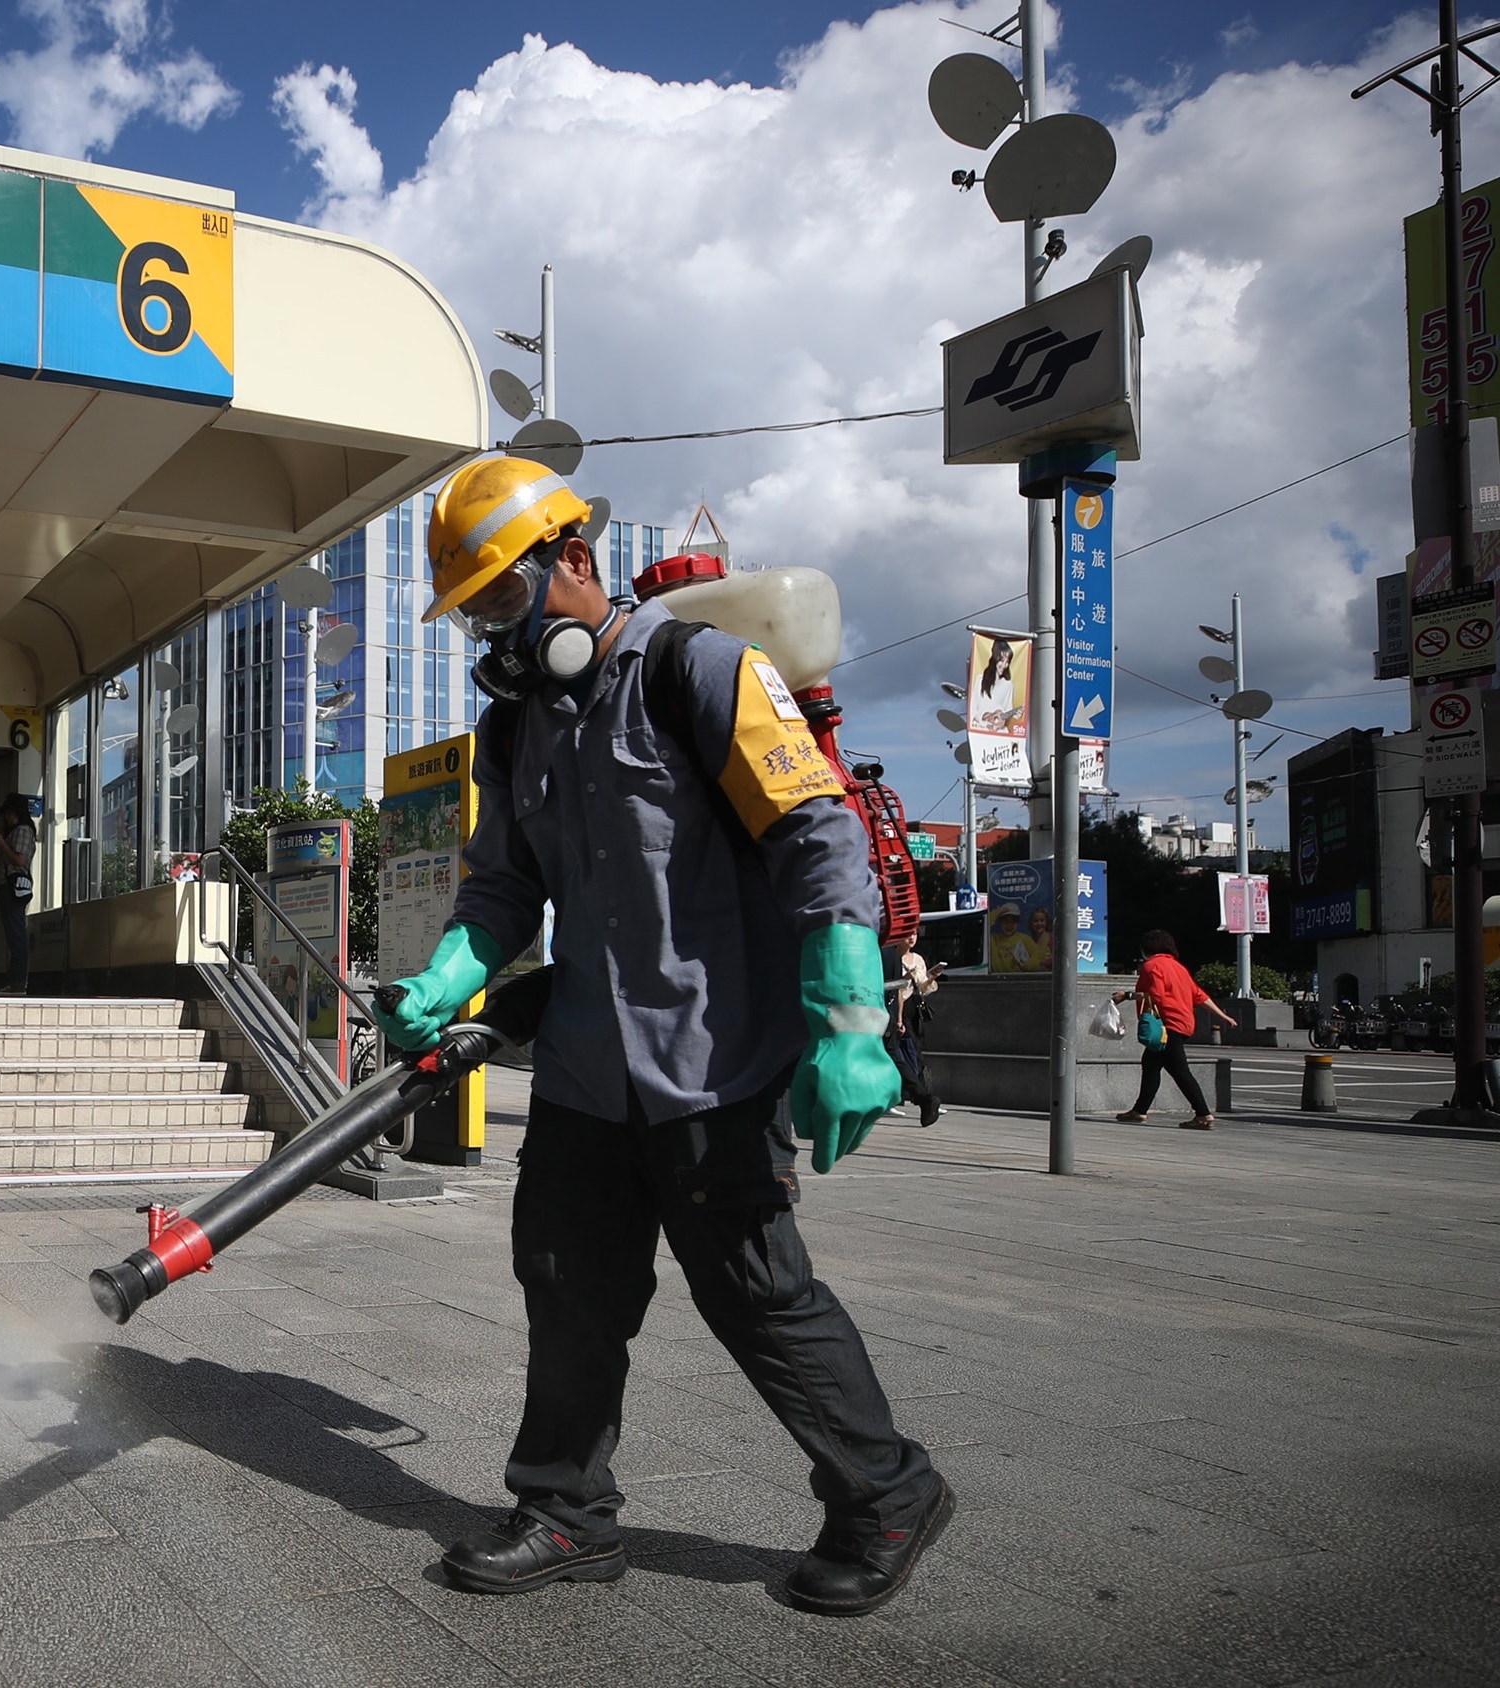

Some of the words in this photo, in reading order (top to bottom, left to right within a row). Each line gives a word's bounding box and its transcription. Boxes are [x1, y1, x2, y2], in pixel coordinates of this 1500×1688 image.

[202, 213, 228, 234] 出入口
[120, 241, 192, 353] 6
[1071, 533, 1086, 632] 服務中心
[1091, 547, 1106, 625] 旅遊
[1442, 611, 1477, 623] SMOKING
[1067, 637, 1095, 651] Visitor
[1067, 652, 1111, 669] Information
[1067, 668, 1095, 681] Center
[10, 718, 30, 750] 6
[763, 739, 822, 775] 環境
[1435, 749, 1480, 761] SIDEWALK
[1306, 901, 1351, 929] 2747-8899
